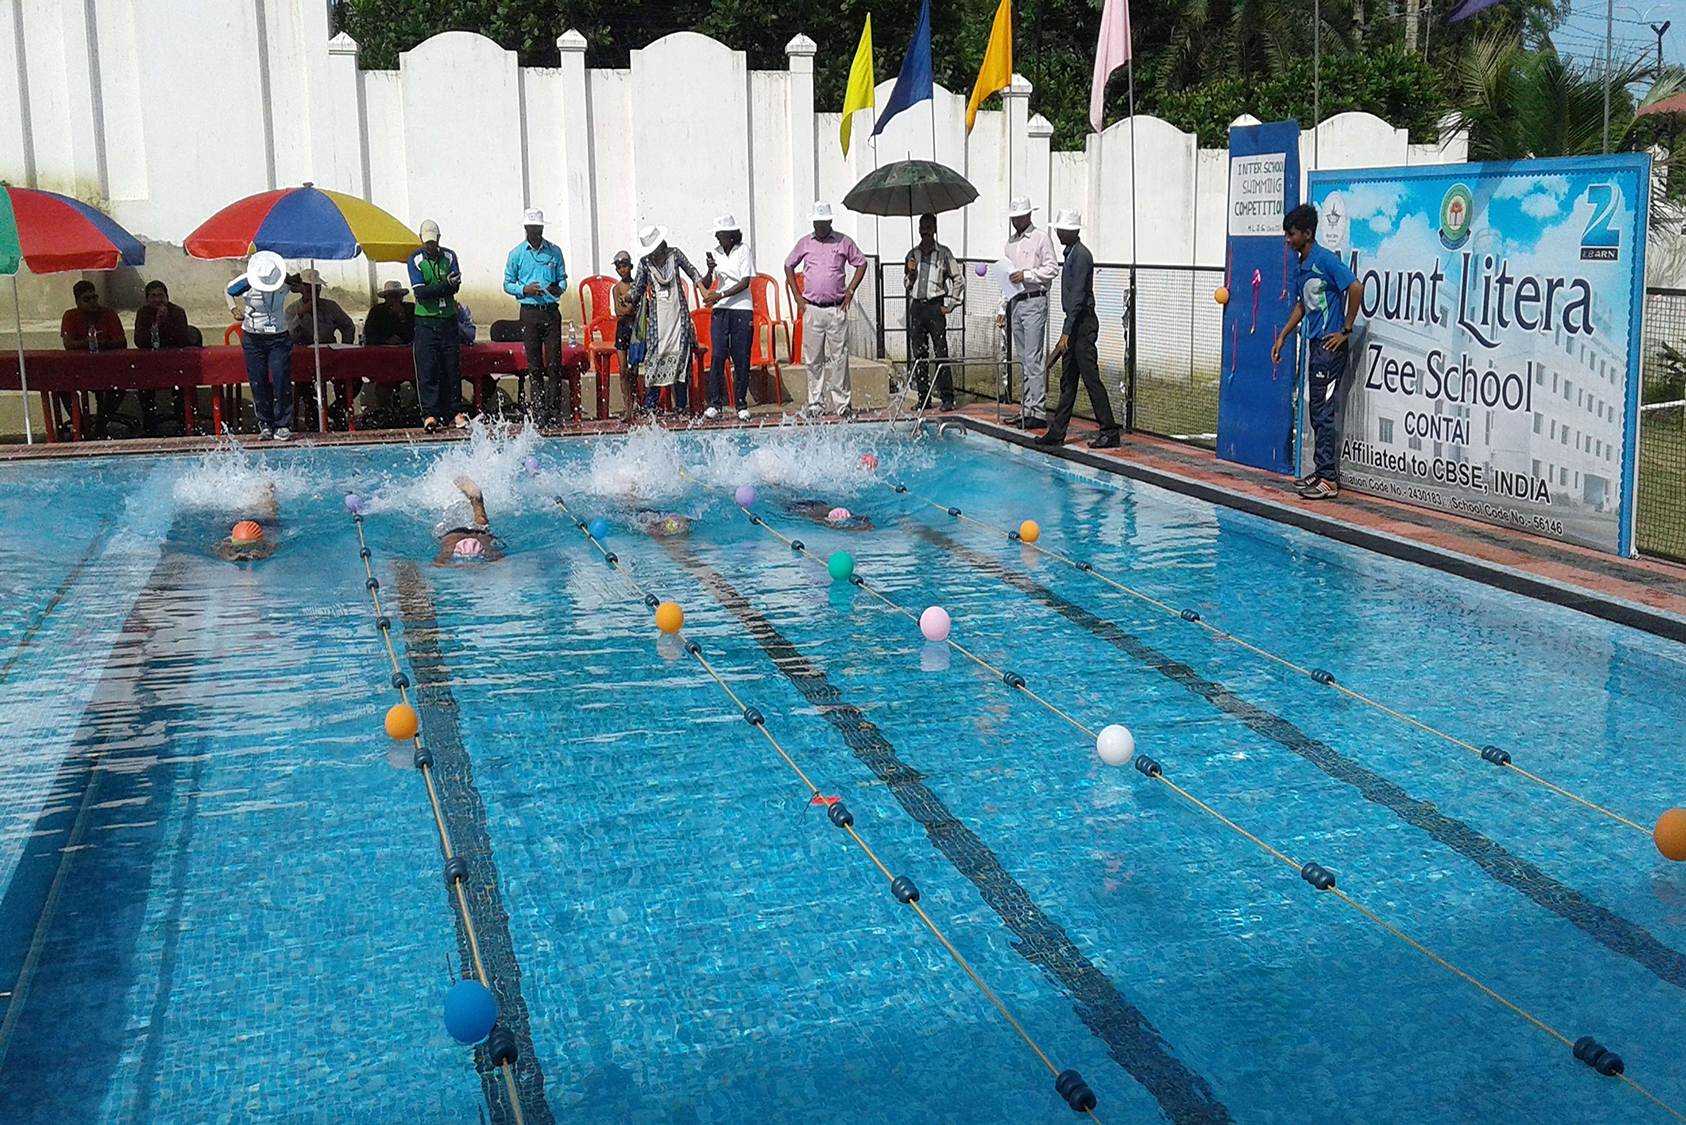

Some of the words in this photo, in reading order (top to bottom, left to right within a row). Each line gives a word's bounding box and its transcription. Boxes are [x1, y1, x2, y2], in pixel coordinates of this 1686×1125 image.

[1238, 162, 1262, 175] INTER
[1263, 161, 1285, 174] SCHOO
[1234, 200, 1283, 216] COMPETITIO
[1582, 249, 1616, 258] LEARN
[1457, 252, 1595, 348] Litera
[1365, 343, 1416, 395] Zee
[1425, 350, 1532, 412] School
[1404, 411, 1470, 446] CONTAI
[1341, 439, 1407, 472] Affiliated
[1411, 454, 1427, 477] to
[1432, 458, 1488, 494] CBSE,
[1494, 470, 1551, 504] INDIA
[1369, 478, 1389, 493] Code
[1408, 487, 1442, 505] 2430183
[1451, 497, 1482, 514] School
[1484, 504, 1509, 521] Code
[1533, 516, 1563, 535] 56146
